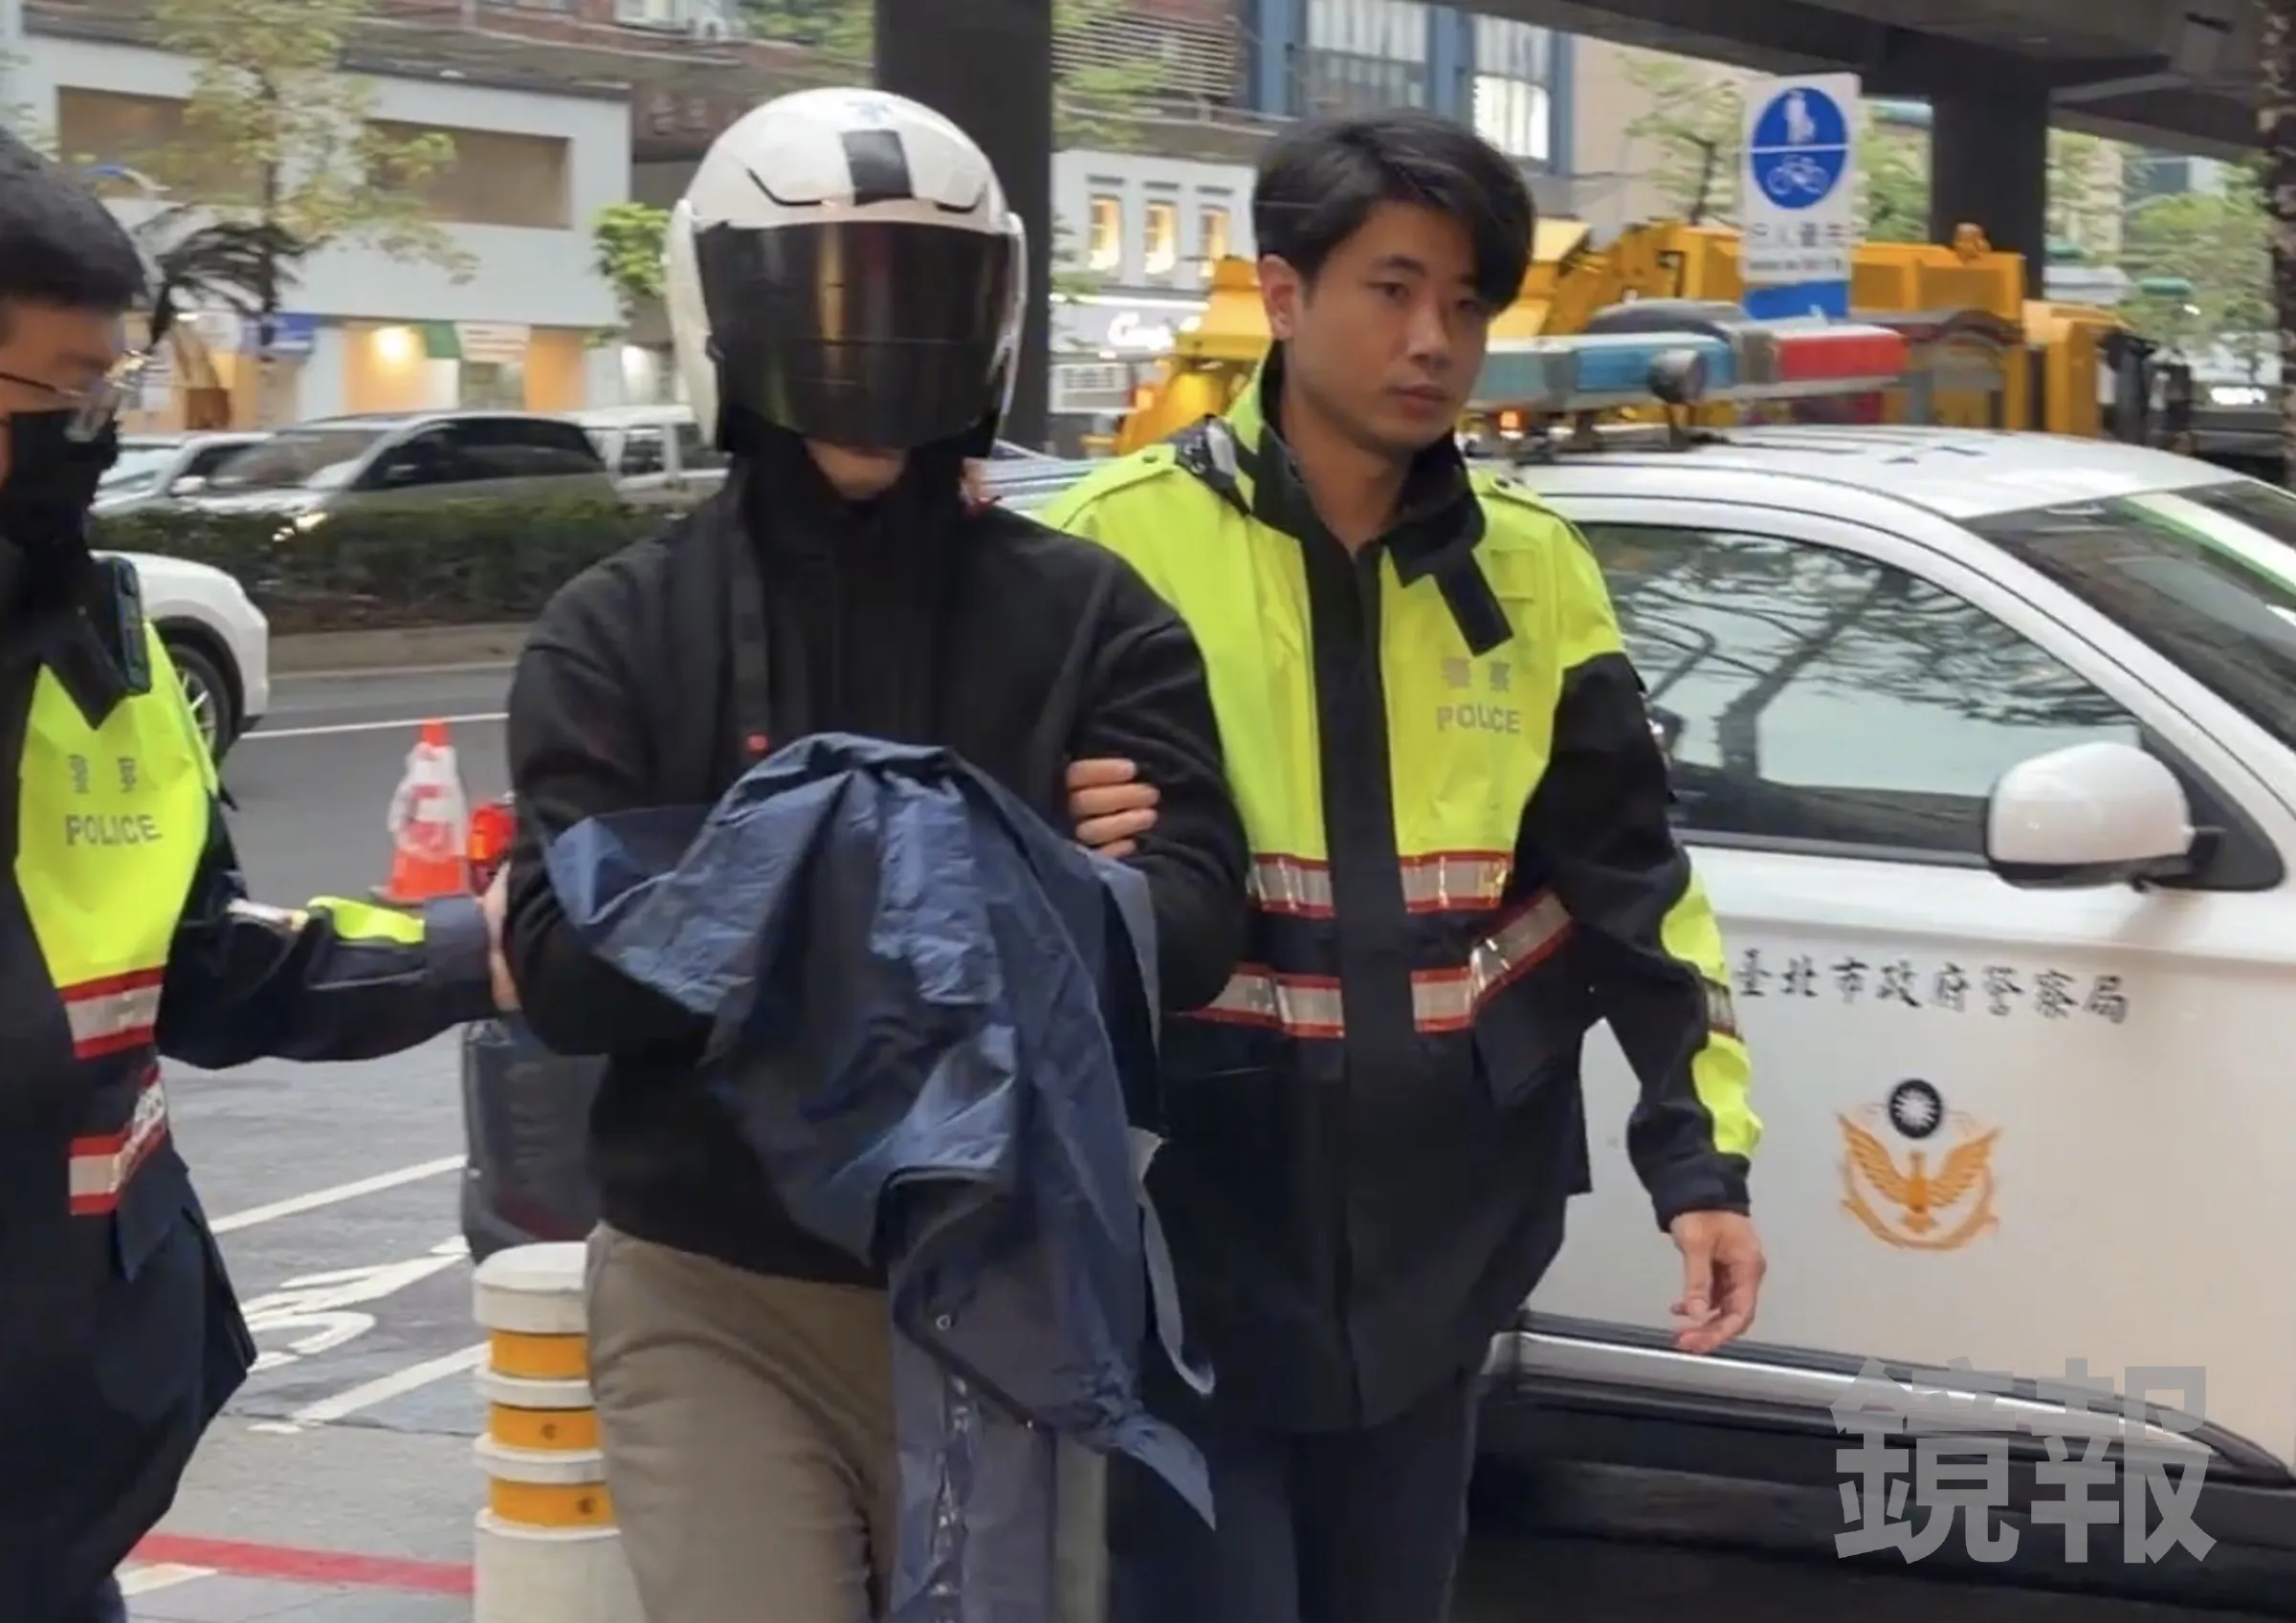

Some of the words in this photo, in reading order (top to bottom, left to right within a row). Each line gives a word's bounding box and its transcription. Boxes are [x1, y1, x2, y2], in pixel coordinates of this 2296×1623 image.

[1436, 704, 1521, 735] POLICE
[65, 814, 163, 846] POLICE
[1733, 947, 2130, 1024] 臺北市政府警察局
